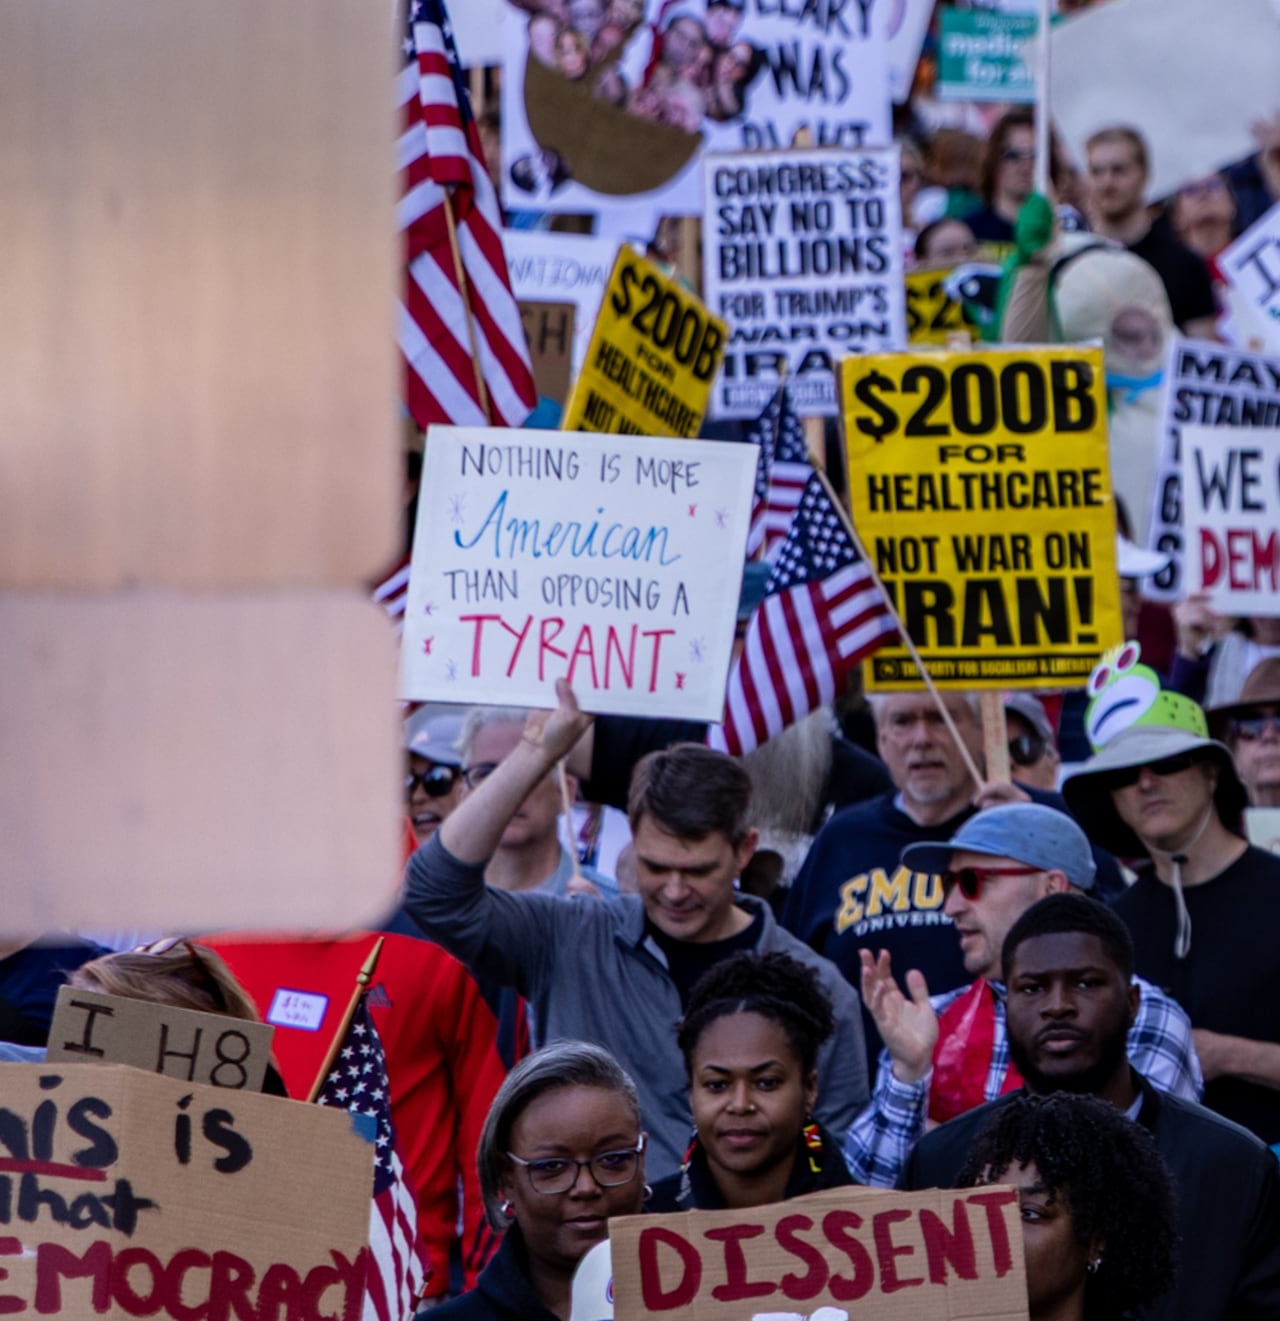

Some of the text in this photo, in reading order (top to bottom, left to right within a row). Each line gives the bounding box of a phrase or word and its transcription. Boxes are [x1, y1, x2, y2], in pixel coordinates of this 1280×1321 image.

[767, 40, 853, 105] WAS
[718, 197, 885, 235] SAY NO TO
[720, 236, 889, 280] BILLIONS
[611, 264, 722, 380] $200B
[720, 291, 764, 320] FOR
[775, 285, 888, 318] TRUMP'S
[727, 322, 888, 343] WAR ON
[594, 339, 700, 437] HEALTHCARE
[637, 343, 677, 381] FOR
[854, 359, 1096, 443] $200B
[461, 443, 701, 494] NOTHING IS MORE
[938, 444, 1027, 464] FOR
[1195, 448, 1263, 512] WE
[868, 468, 1103, 512] HEALTHCARE
[455, 490, 682, 567] American
[875, 532, 1092, 576] NOT WAR ON
[443, 569, 691, 616] THAN OPPOSING A
[459, 615, 677, 693] TYRANT
[834, 865, 945, 936] EMU
[63, 999, 251, 1090] I H8
[174, 1093, 254, 1173] is
[638, 1190, 1018, 1312] DISSENT
